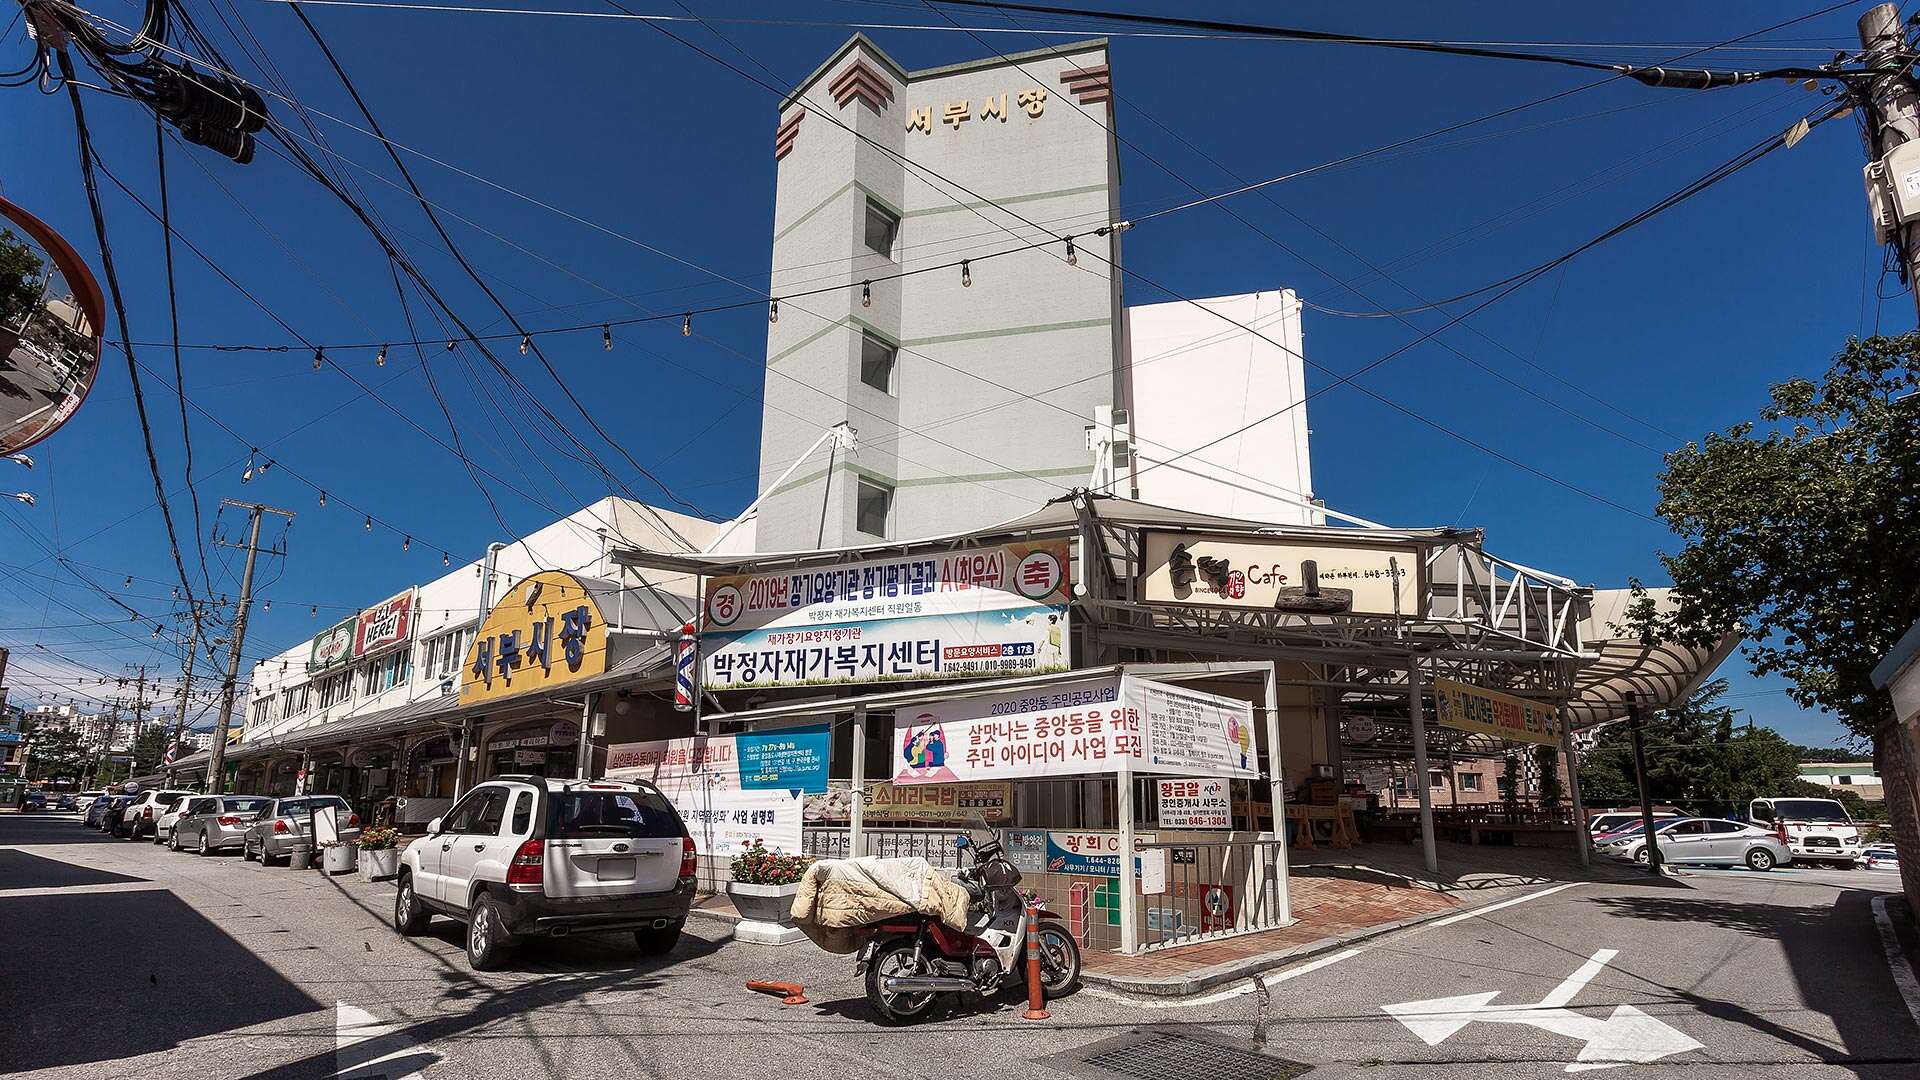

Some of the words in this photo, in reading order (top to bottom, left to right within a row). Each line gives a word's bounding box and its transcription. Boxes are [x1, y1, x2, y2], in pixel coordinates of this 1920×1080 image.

[905, 88, 1047, 136] 서부시장
[748, 576, 788, 611] 2019년
[790, 568, 860, 606] 장기요양기관
[863, 560, 937, 599] 정기평가결과
[940, 551, 1005, 593] A(최우수)
[1023, 561, 1050, 588] 축
[1248, 565, 1288, 588] Cafe
[374, 601, 395, 624] EAT
[716, 594, 735, 619] 경
[808, 611, 833, 621] 박정자
[834, 603, 885, 619] 재가복지센터
[887, 601, 922, 615] 직원일동
[365, 614, 397, 645] HERE!
[767, 628, 862, 646] 재가장기요양지정기관
[472, 605, 591, 690] 서부시장
[945, 645, 998, 658] 방문요양서비스
[1002, 644, 1014, 655] 2층
[1017, 643, 1034, 655] 17호
[713, 639, 941, 684] 박정자재가복지센터
[991, 702, 1017, 716] 2020
[1018, 697, 1049, 714] 중앙동
[1051, 686, 1115, 710] 주민공모사업
[968, 720, 1029, 746] 살맛나는
[1033, 710, 1103, 739] 중앙동을
[1109, 706, 1140, 731] 위한
[661, 748, 686, 766] 회원을
[966, 747, 995, 769] 주민
[1001, 739, 1065, 766] 아이디어
[1071, 735, 1106, 761] 사업
[1113, 734, 1142, 758] 모집
[1160, 782, 1199, 797] 황금알
[1161, 798, 1200, 809] 공인중개사
[1202, 798, 1228, 808] 사무소
[732, 810, 748, 825] 사업
[750, 810, 775, 825] 설명회
[1188, 816, 1227, 826] 646-1304
[1066, 835, 1101, 853] 광희
[1089, 864, 1106, 873] 모니터
